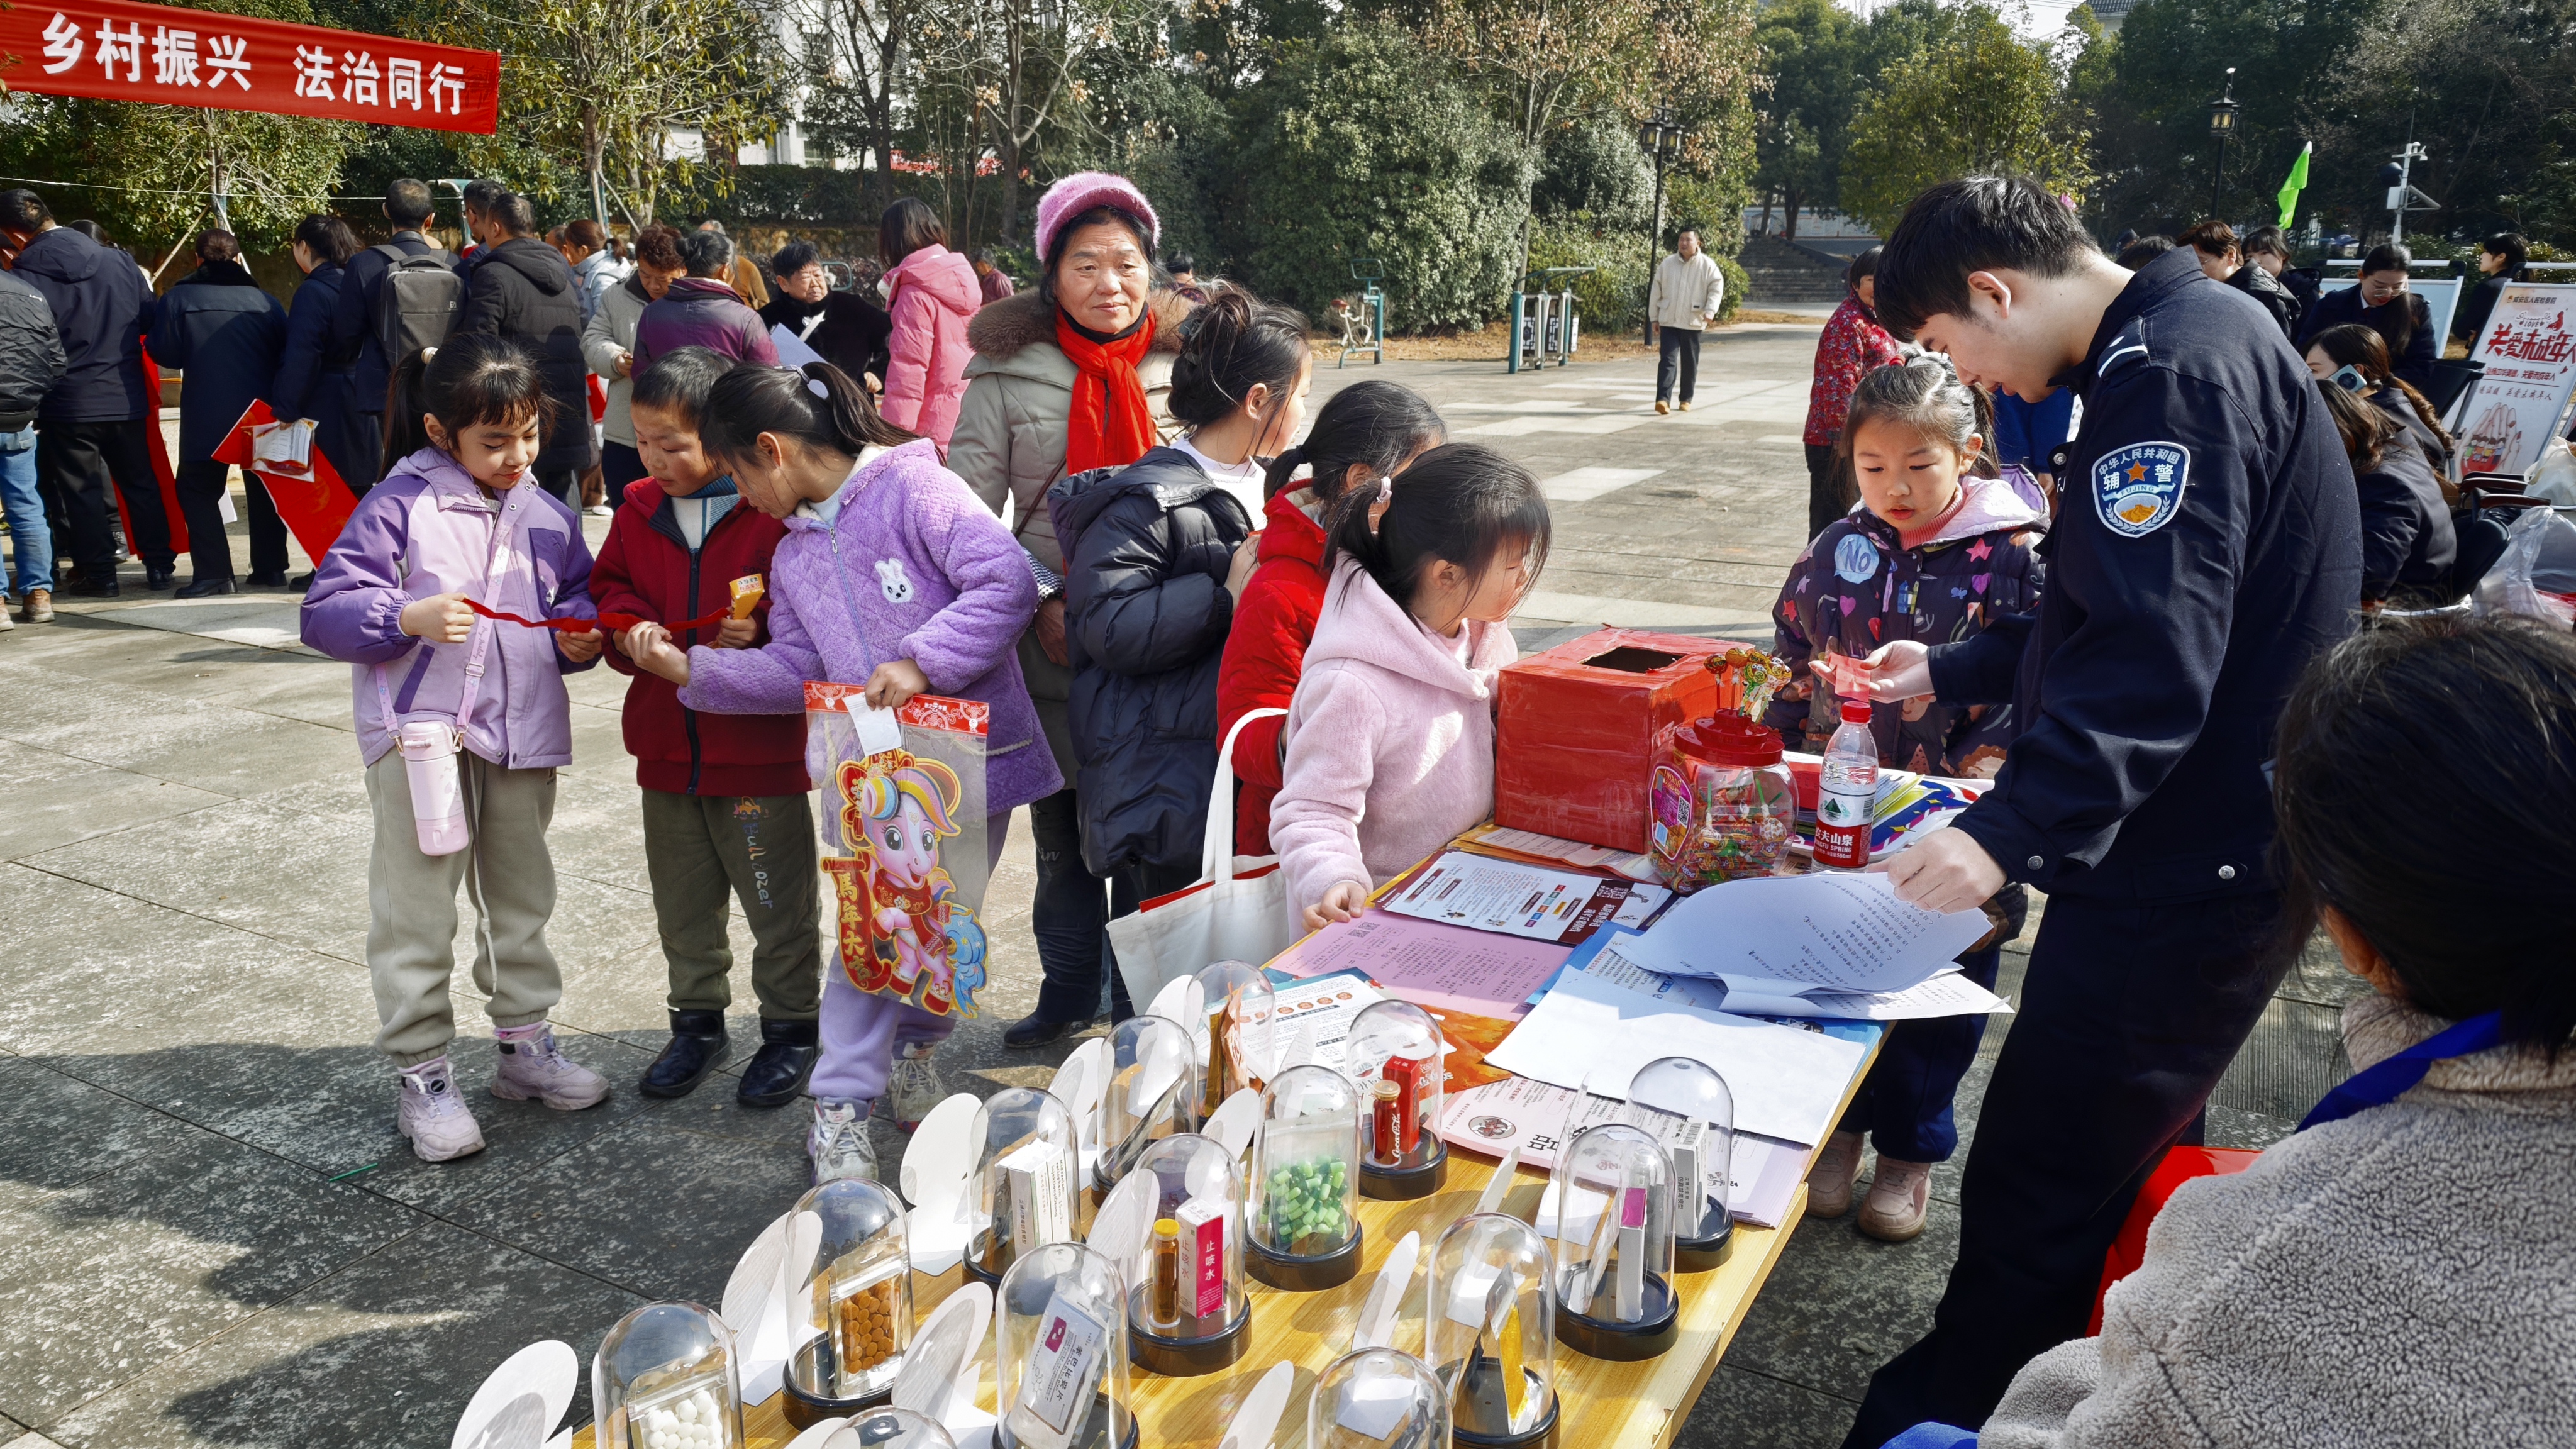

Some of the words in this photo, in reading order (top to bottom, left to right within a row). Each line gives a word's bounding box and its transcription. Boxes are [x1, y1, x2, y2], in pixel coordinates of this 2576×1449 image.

[42, 11, 252, 91] 乡村振兴
[293, 44, 465, 116] 法治同行
[2485, 323, 2576, 364] 关爱未成年人
[2098, 448, 2181, 475] 中华人民共和国
[2121, 486, 2154, 496] FUJING
[836, 873, 870, 982] 馬年大吉
[1205, 1240, 1215, 1281] 止咳水
[1055, 1345, 1083, 1401] 苯巴比妥片
